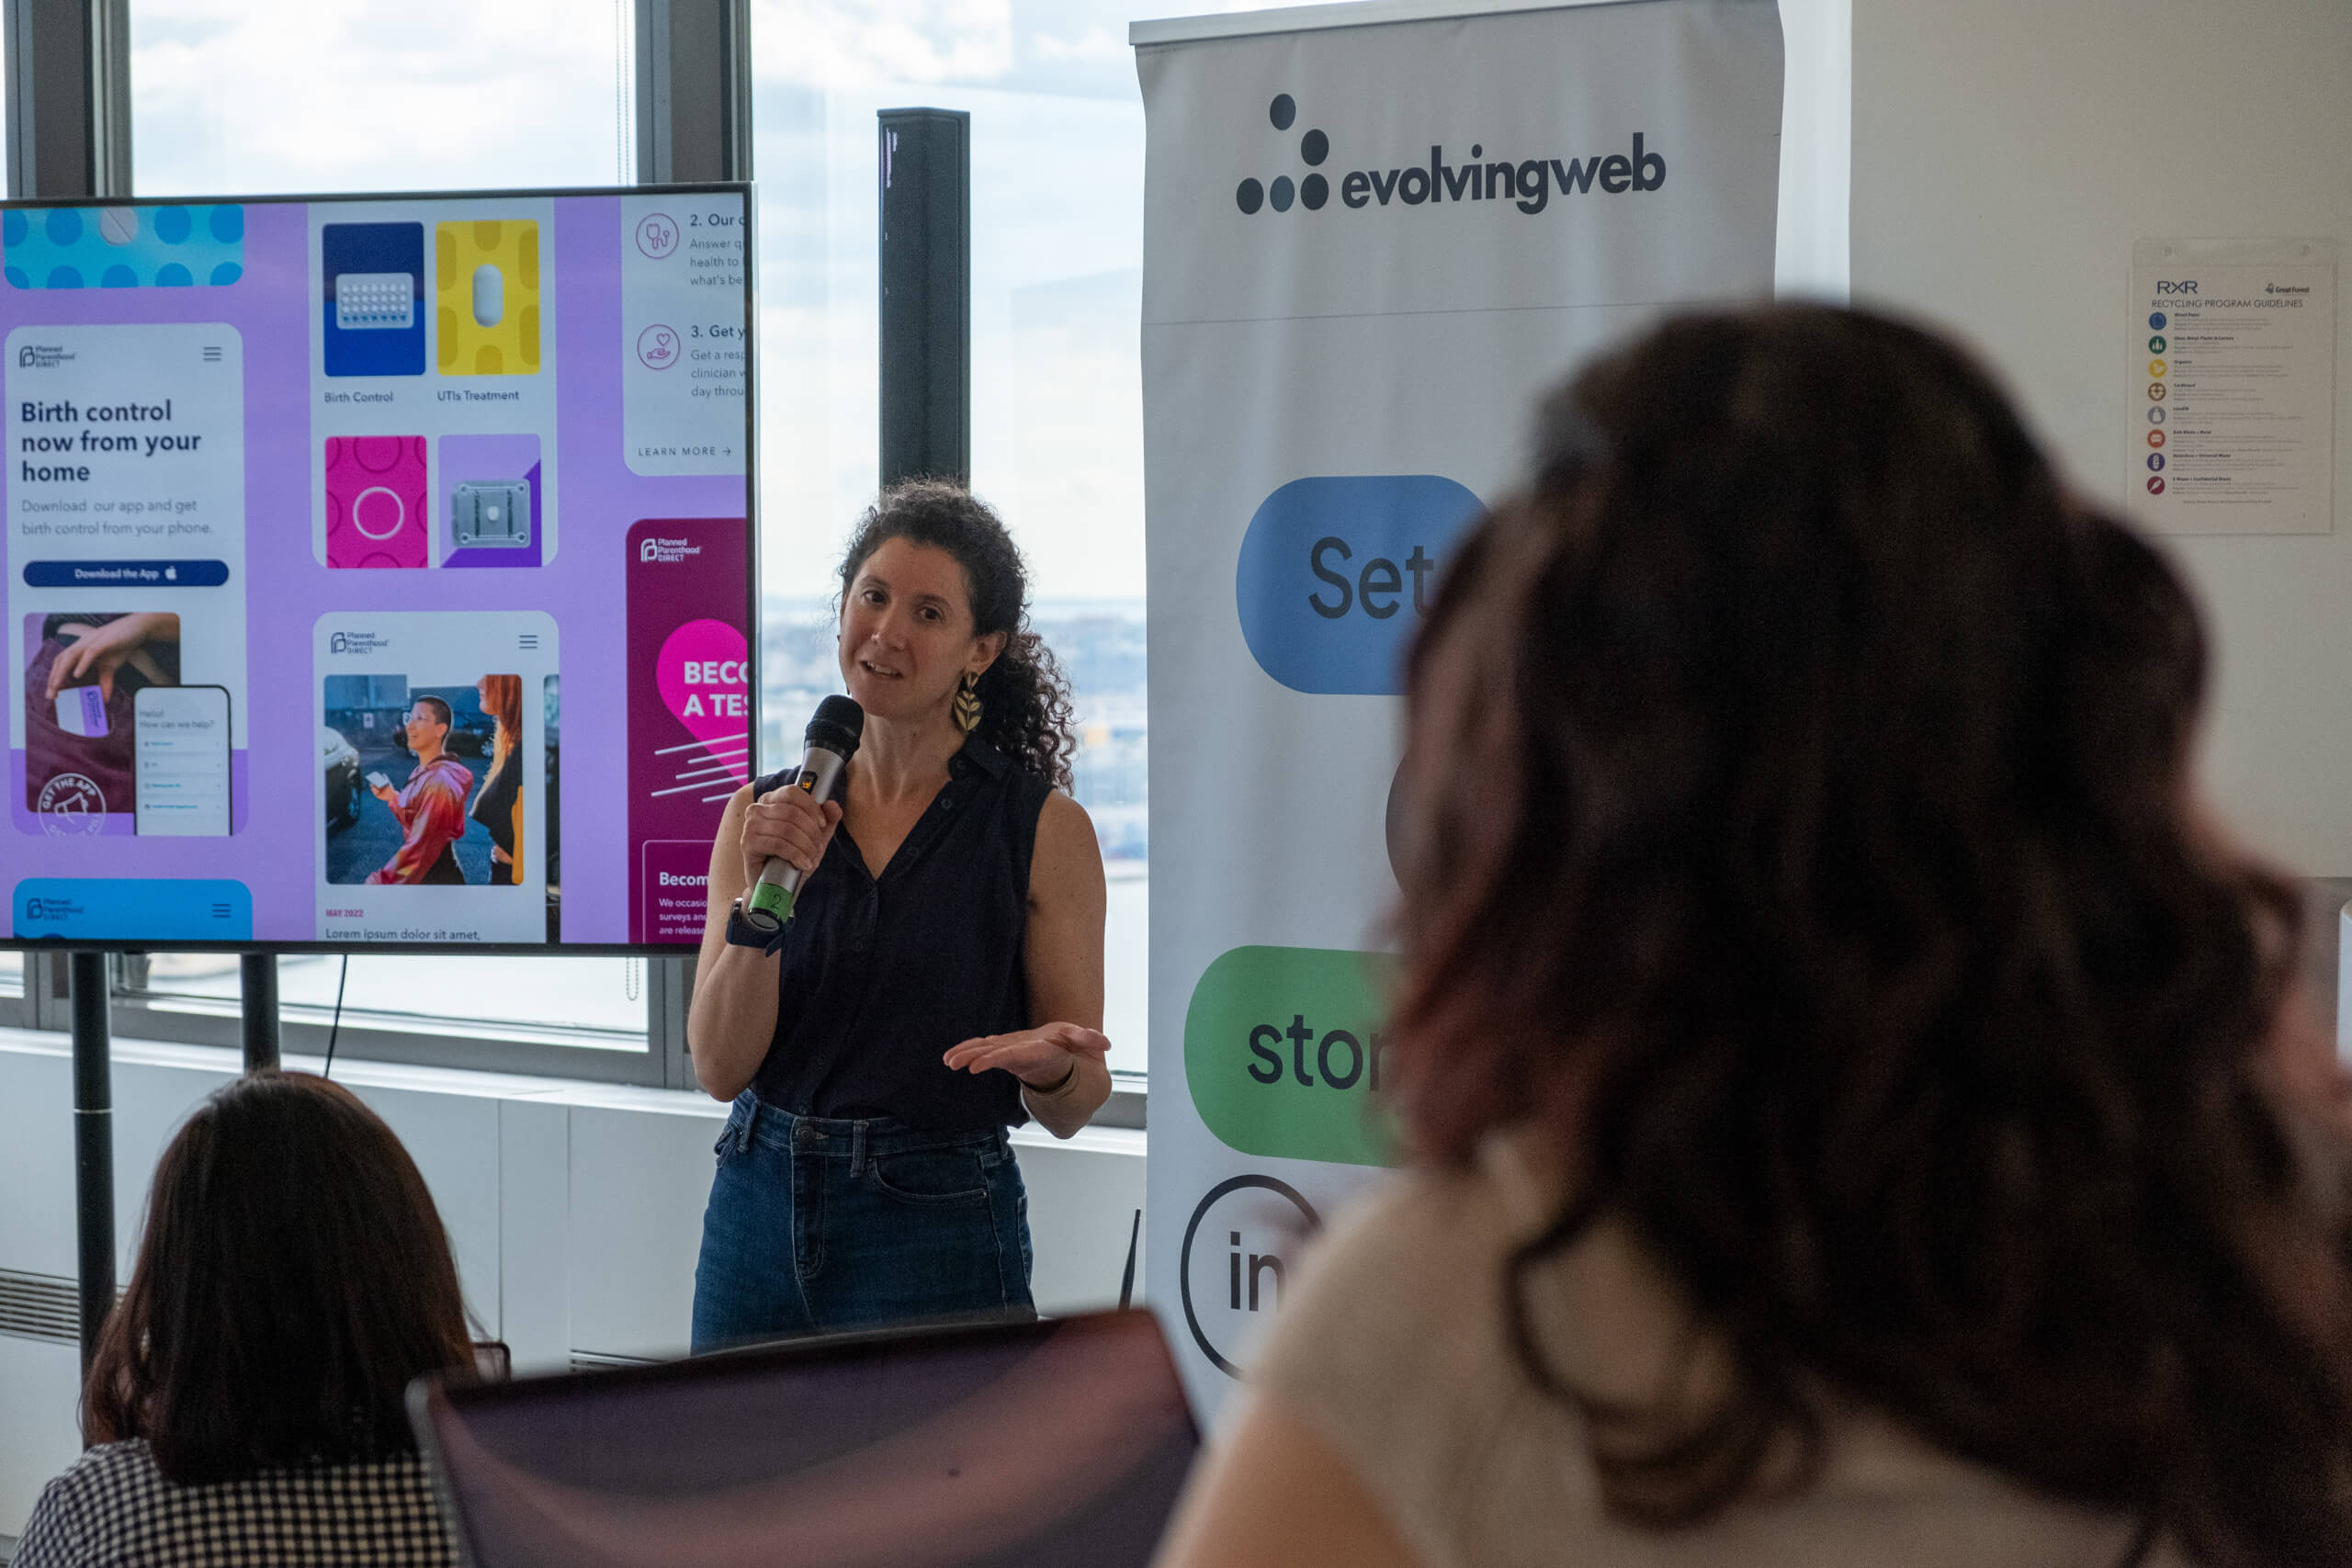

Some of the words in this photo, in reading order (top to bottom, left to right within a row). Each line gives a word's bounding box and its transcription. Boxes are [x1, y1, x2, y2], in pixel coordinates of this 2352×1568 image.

[1340, 130, 1668, 216] evolvingweb
[690, 213, 703, 227] 2.
[707, 213, 735, 227] Our
[690, 238, 730, 249] Answer
[690, 256, 724, 267] health
[728, 258, 740, 266] to
[690, 276, 726, 286] what's
[2156, 280, 2199, 295] RXR
[2151, 299, 2202, 309] RECYCLING
[2204, 299, 2252, 309] PROGRAM
[2253, 299, 2304, 309] GUIDELINES
[690, 324, 704, 338] 3.
[708, 324, 735, 338] Get
[690, 350, 712, 361] Get
[714, 352, 721, 361] a
[690, 367, 736, 378] clinician
[324, 391, 350, 403] Birth
[352, 390, 394, 403] Control
[436, 389, 460, 401] UTIs
[463, 389, 520, 401] Treatment
[690, 385, 712, 400] day
[714, 385, 744, 397] throu
[21, 400, 79, 423] Birth
[85, 398, 172, 423] control
[21, 435, 74, 453] now
[80, 429, 139, 452] from
[144, 434, 202, 457] your
[638, 446, 677, 457] LEARN
[681, 446, 717, 456] MORE
[21, 459, 91, 482] home
[21, 499, 87, 513] Download
[93, 502, 116, 513] our
[119, 502, 145, 515] app
[146, 499, 173, 513] and
[175, 502, 198, 514] get
[21, 522, 52, 536] birth
[54, 521, 100, 536] control
[102, 520, 133, 535] from
[135, 524, 164, 537] your
[167, 520, 214, 536] phone.
[658, 537, 688, 546] Planned
[658, 554, 685, 562] DIRECT
[74, 568, 122, 580] Download
[122, 568, 138, 580] the
[139, 568, 160, 581] App
[1308, 536, 1435, 621] Set
[682, 693, 706, 717] A
[708, 693, 749, 717] TE
[658, 897, 673, 908] We
[771, 893, 782, 910] 2
[324, 908, 343, 918] MAY
[344, 908, 365, 918] 2022
[659, 913, 692, 924] surveys
[325, 928, 361, 940] Lorem
[363, 927, 398, 941] ipsum
[400, 928, 431, 940] dolor
[433, 928, 447, 940] sit
[448, 929, 481, 942] amet,
[659, 926, 673, 935] are
